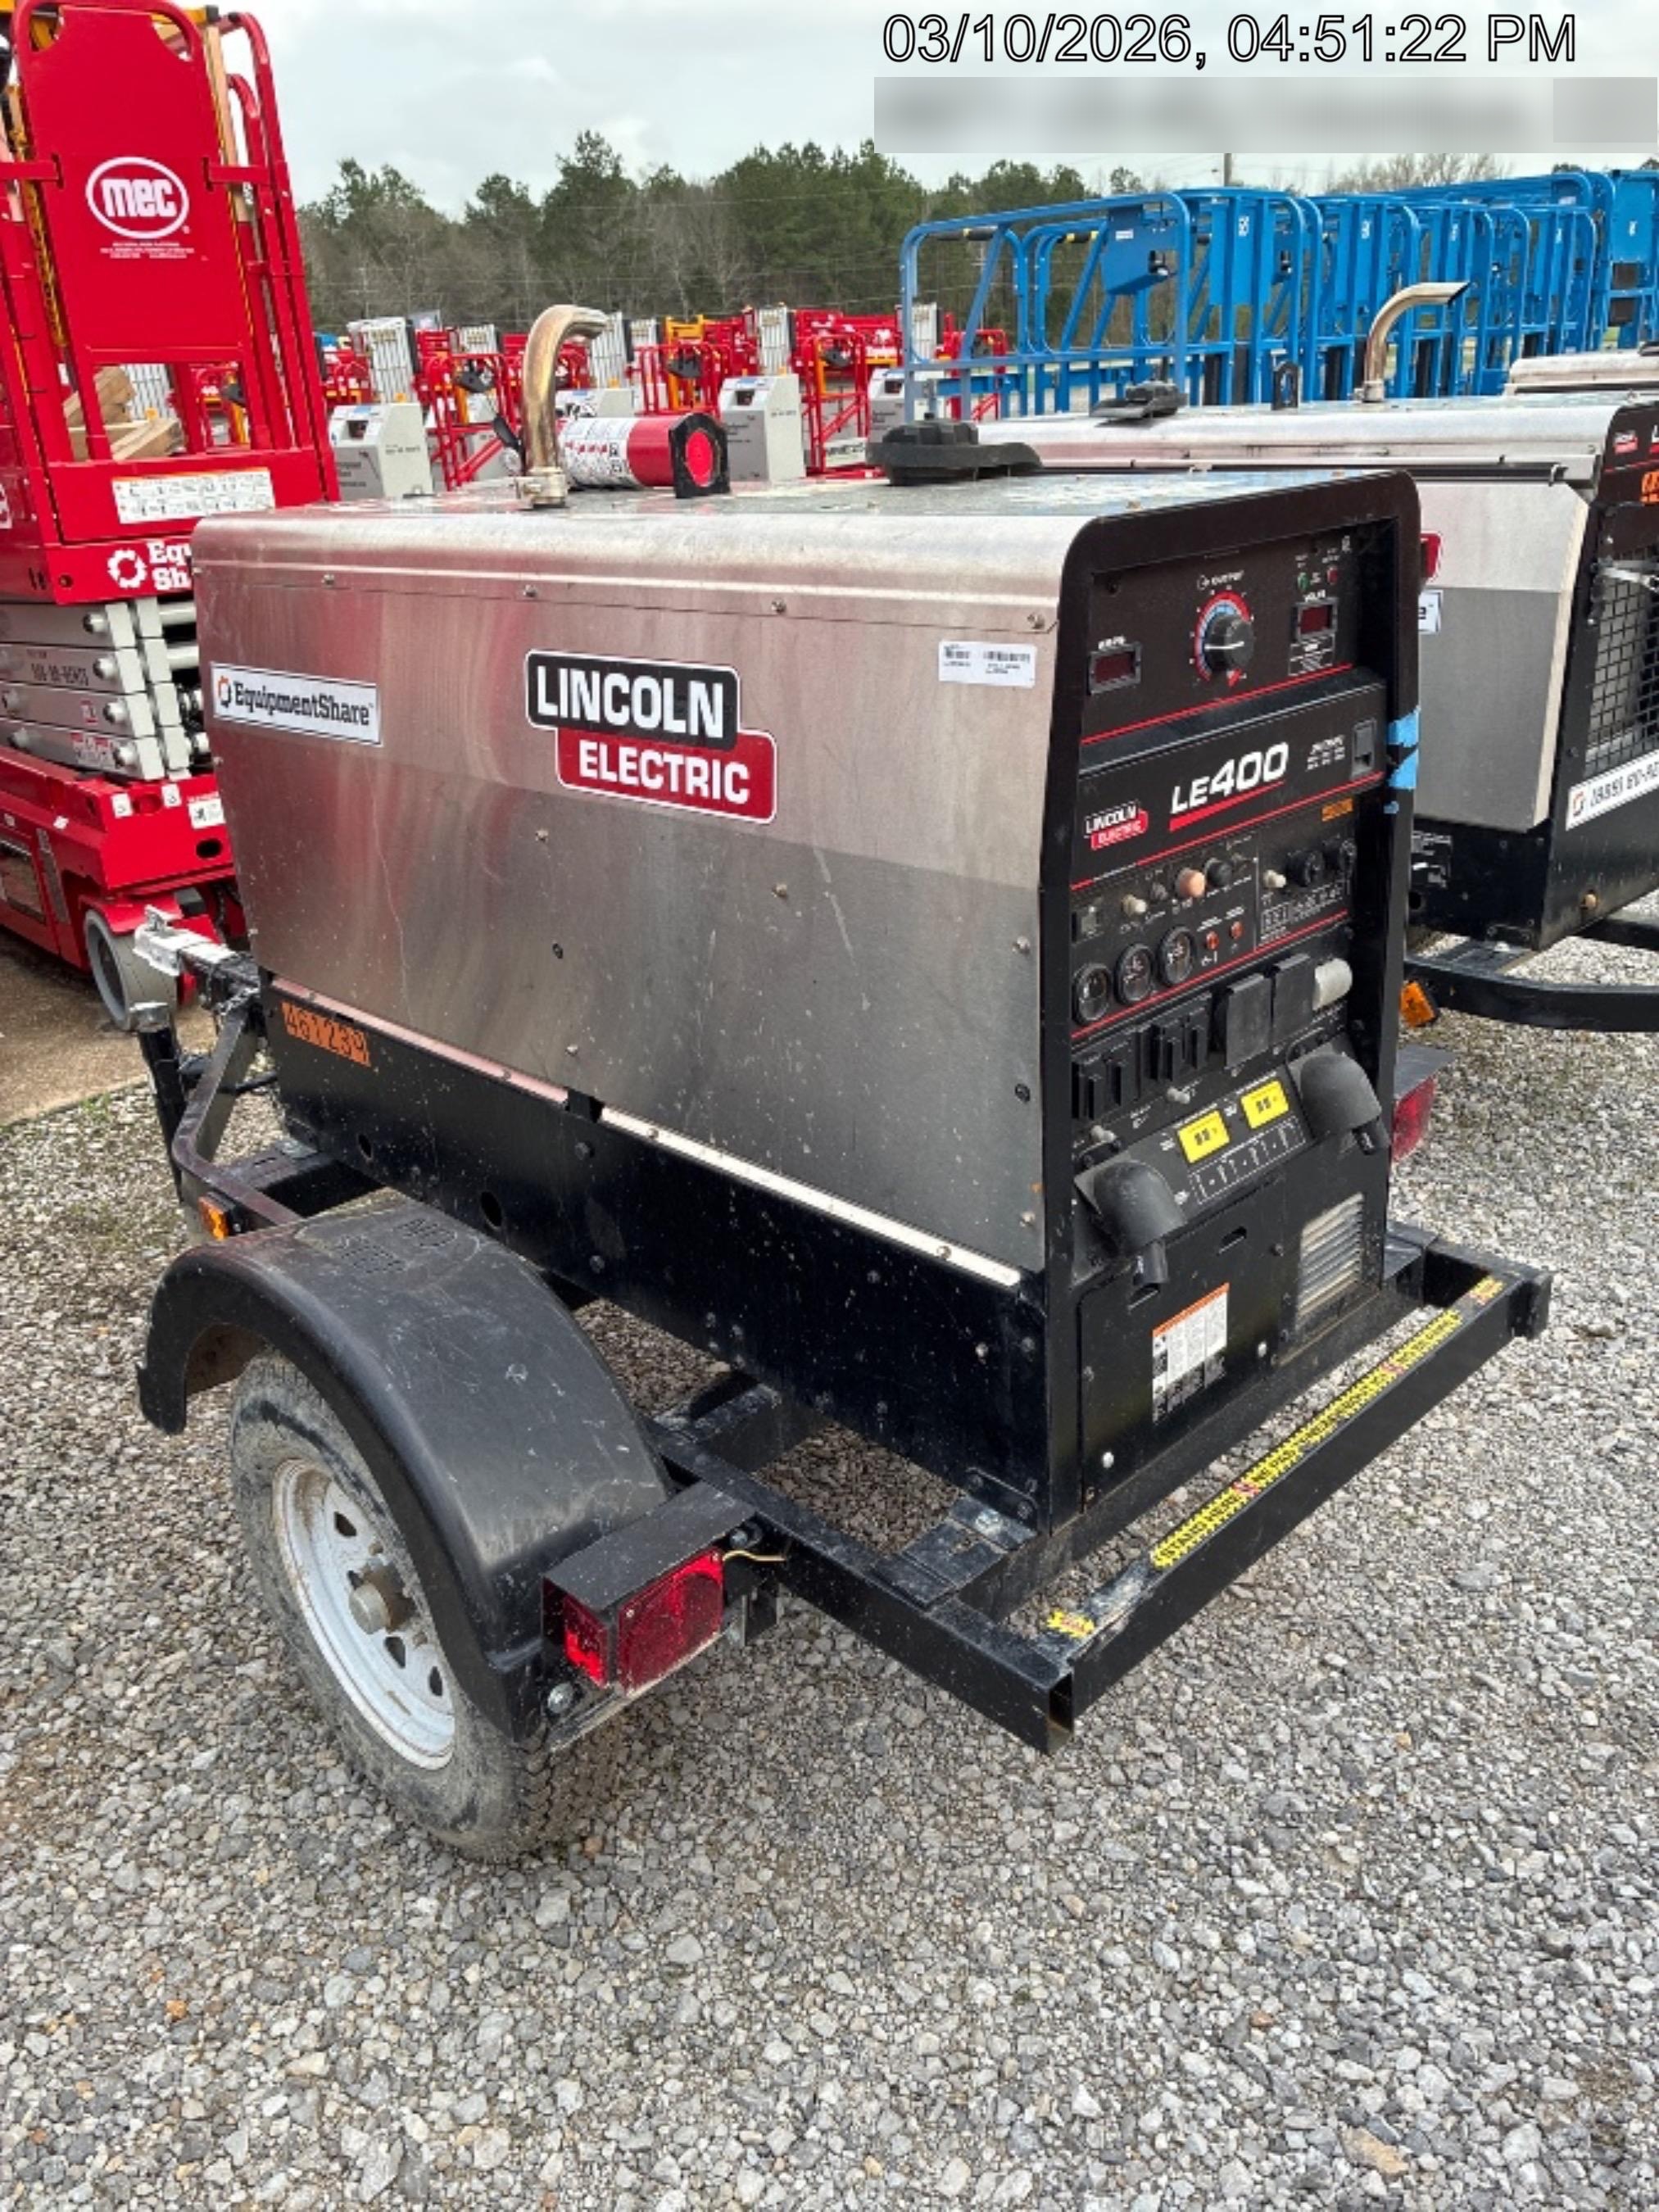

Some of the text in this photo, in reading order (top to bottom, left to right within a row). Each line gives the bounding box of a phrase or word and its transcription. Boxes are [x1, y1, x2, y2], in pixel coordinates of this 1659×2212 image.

[233, 681, 369, 725] EquipmentShare
[537, 665, 723, 739] LINCOLN
[578, 739, 750, 805] ELECTRIC
[1172, 742, 1289, 814] LE400
[1086, 805, 1136, 833] LINCOLN
